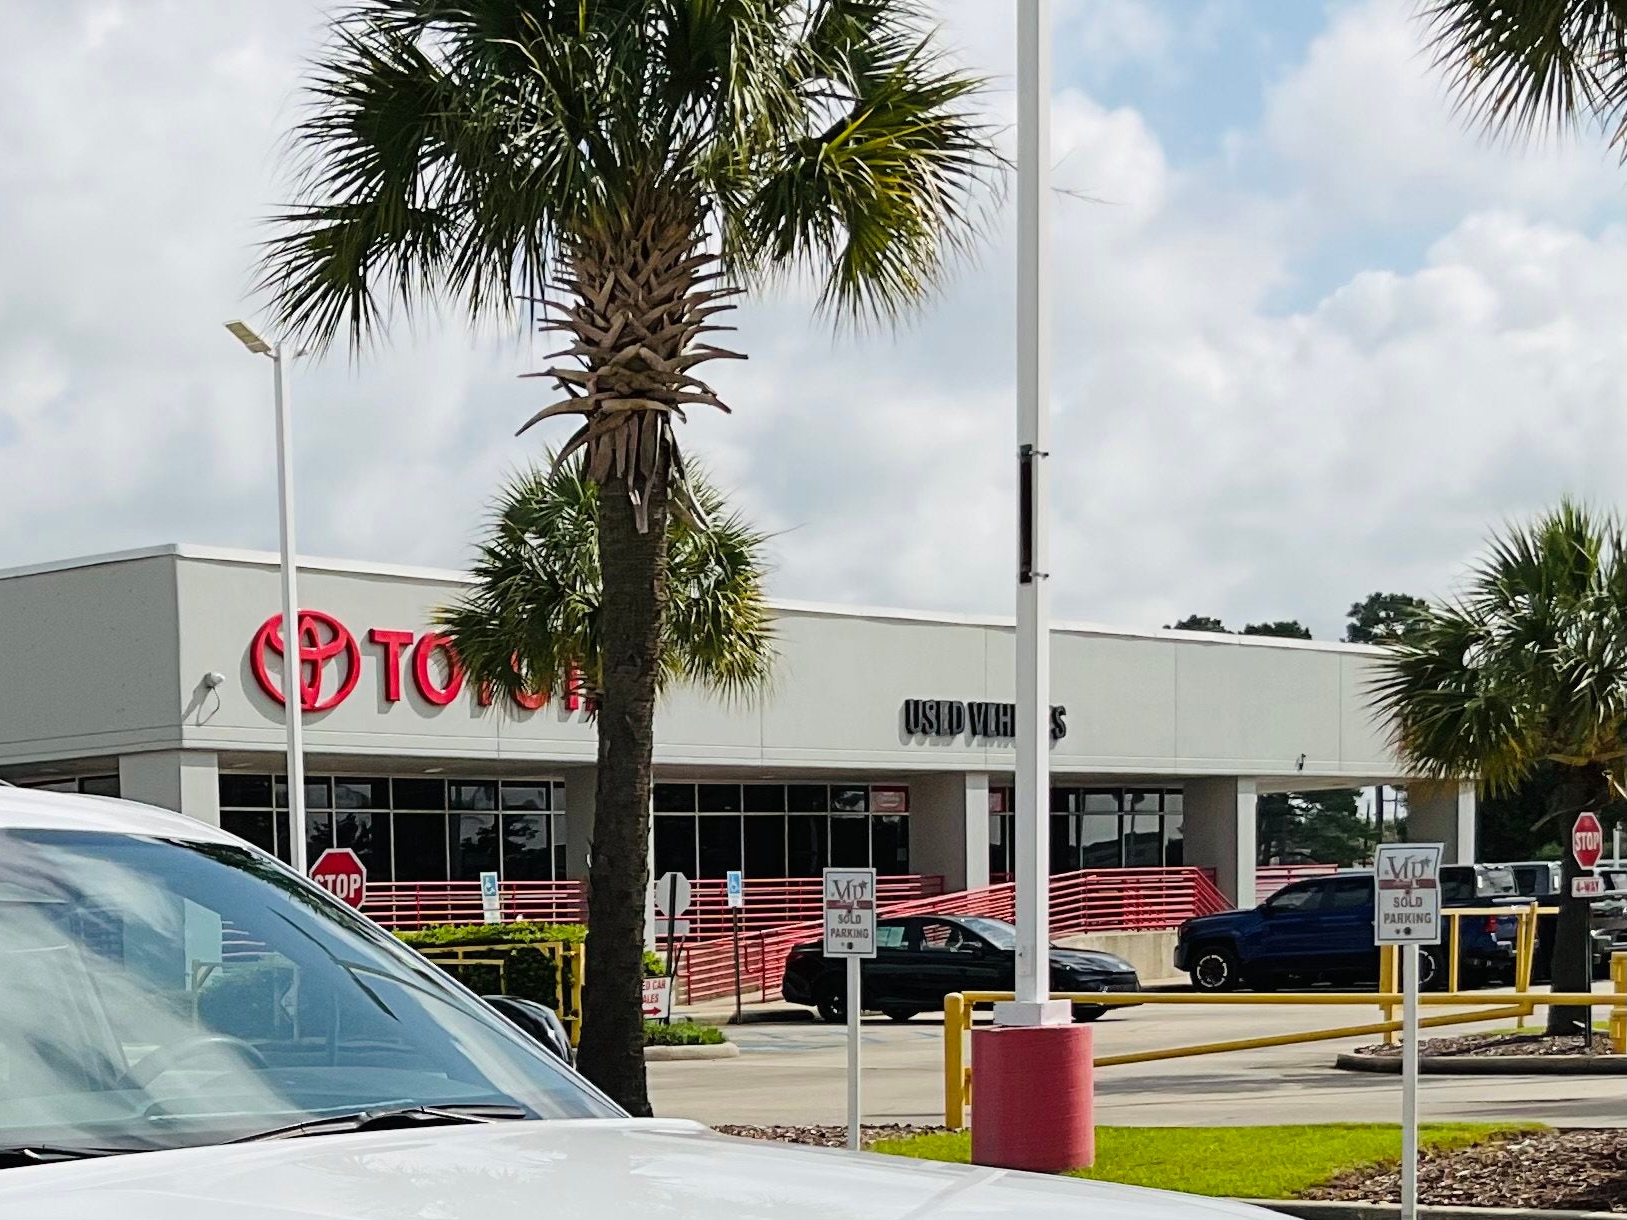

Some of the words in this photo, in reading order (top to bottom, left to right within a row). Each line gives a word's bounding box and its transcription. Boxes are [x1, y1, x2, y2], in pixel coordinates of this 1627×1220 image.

[904, 699, 966, 737] USED
[1575, 832, 1600, 851] STOP
[1576, 881, 1600, 893] 4-WAY
[1393, 896, 1423, 908] SOLD
[837, 913, 862, 924] SOLD
[1383, 912, 1432, 924] PARKING
[830, 928, 870, 939] PARKING
